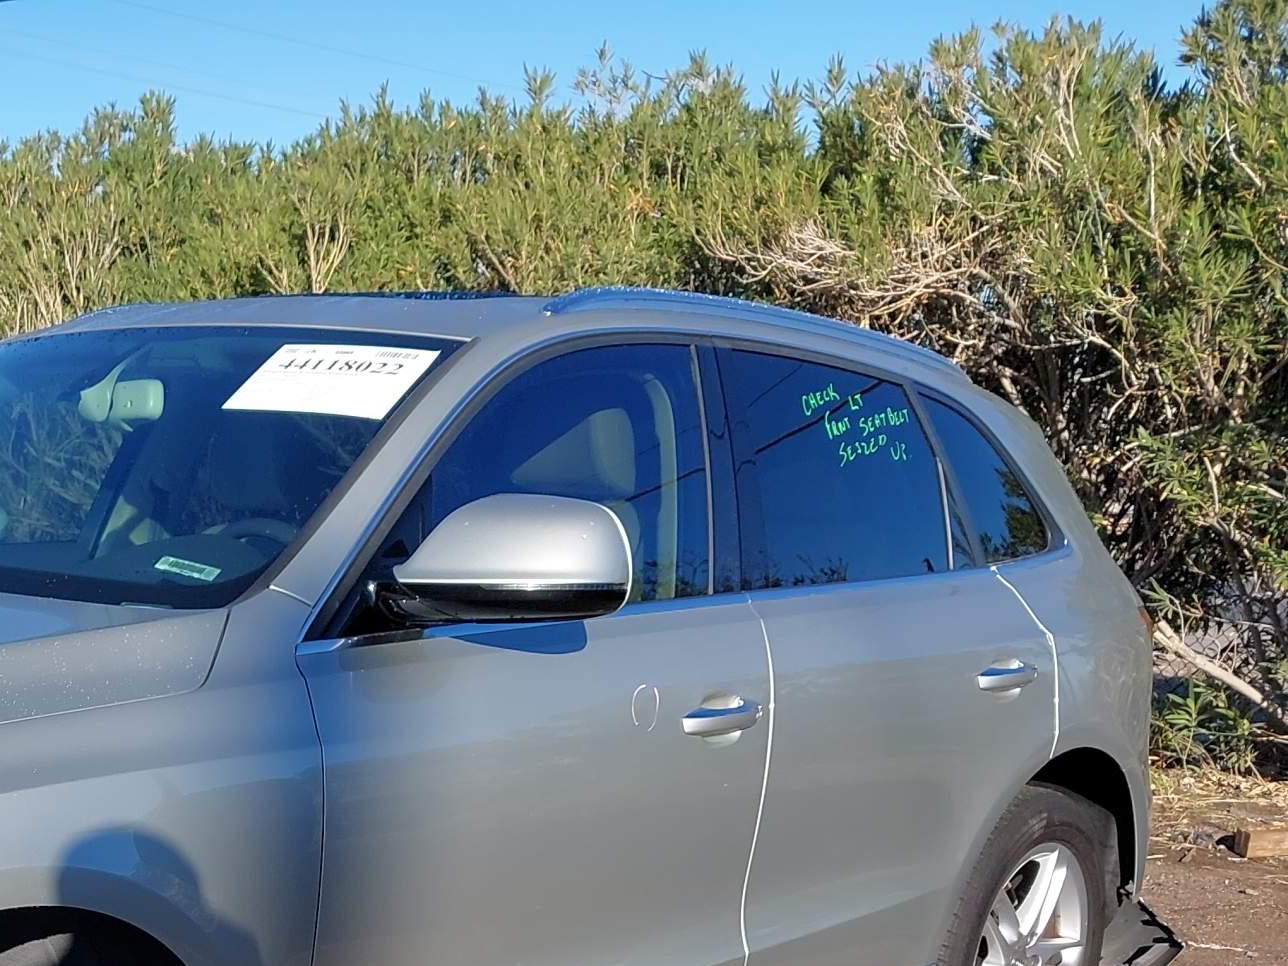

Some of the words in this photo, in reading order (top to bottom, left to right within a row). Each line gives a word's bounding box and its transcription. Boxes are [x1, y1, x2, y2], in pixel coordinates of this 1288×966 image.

[279, 358, 404, 375] 44118022
[802, 384, 840, 416] CHECK
[848, 393, 864, 411] LT
